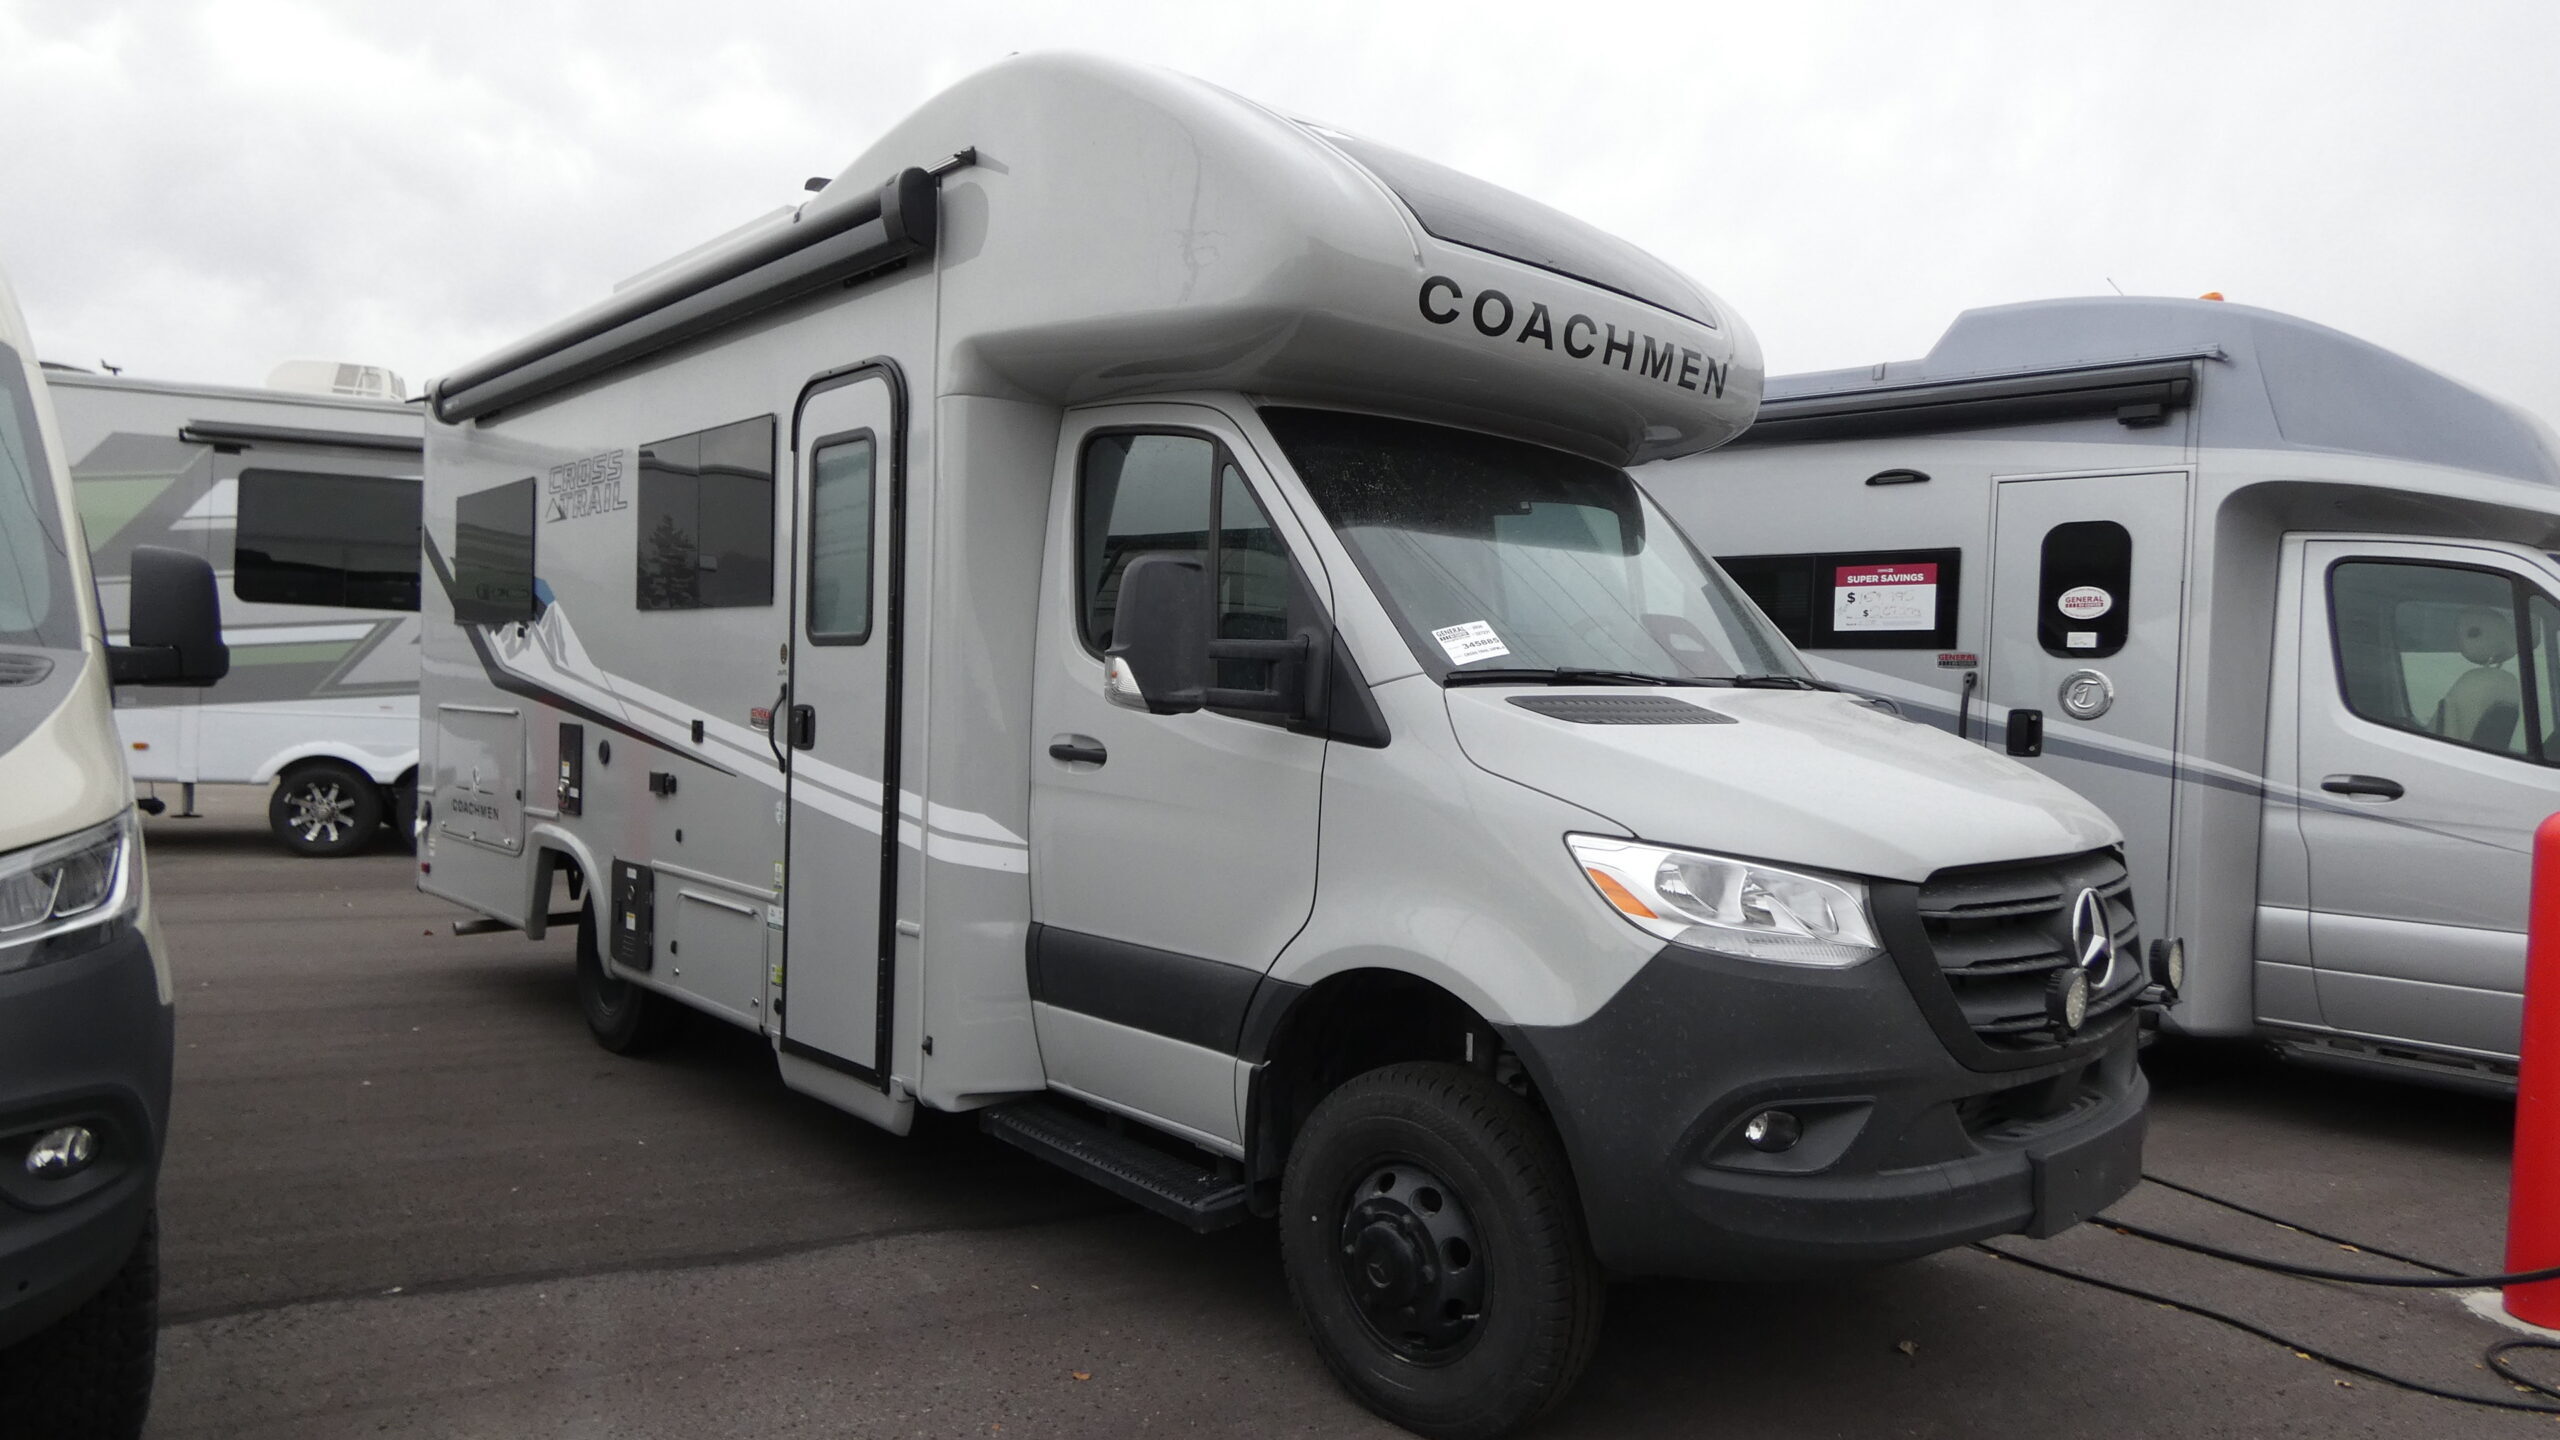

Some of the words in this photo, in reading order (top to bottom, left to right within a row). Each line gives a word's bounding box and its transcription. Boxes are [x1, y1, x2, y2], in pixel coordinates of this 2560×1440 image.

[1418, 275, 1728, 399] COACHMEN
[549, 449, 623, 494] CROSS
[560, 481, 628, 519] TRAIL
[1847, 575, 1879, 584] SUPER
[1881, 573, 1924, 583] SAVINGS
[1847, 592, 1856, 604] $
[452, 799, 499, 820] COACHMEN
